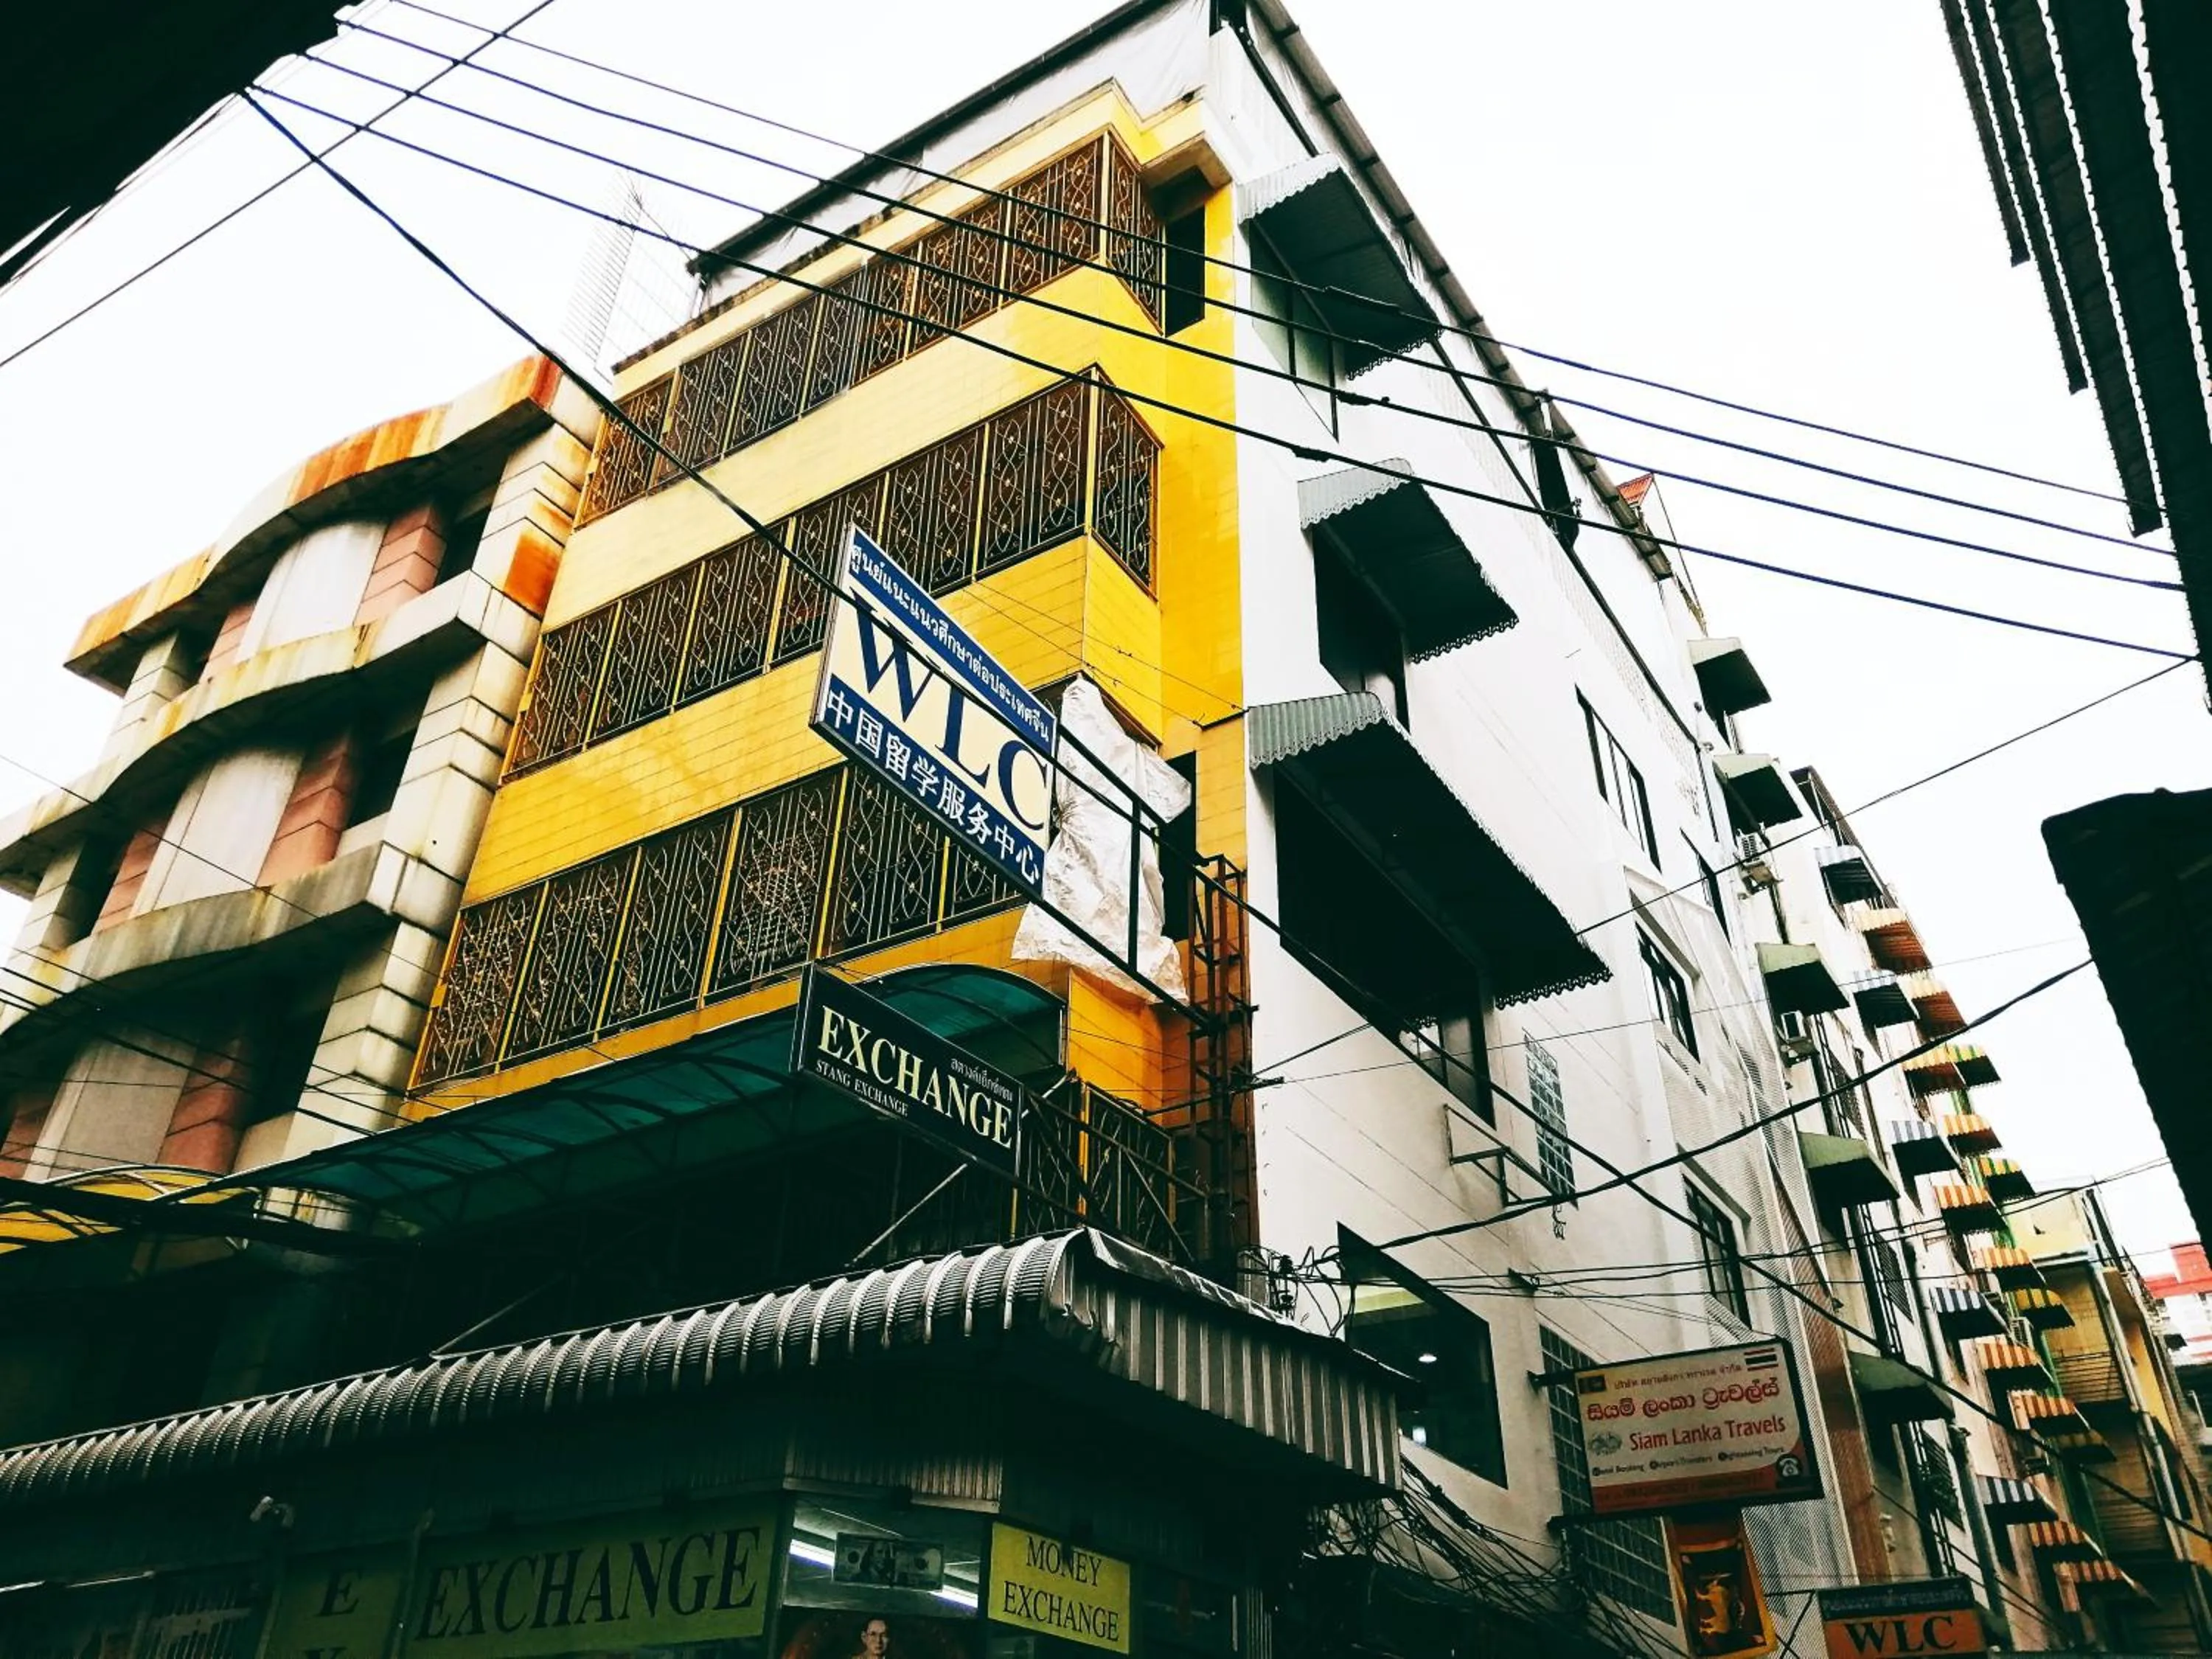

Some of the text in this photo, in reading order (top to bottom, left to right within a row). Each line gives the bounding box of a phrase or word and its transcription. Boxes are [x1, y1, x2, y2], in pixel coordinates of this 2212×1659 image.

[849, 586, 1048, 831] WLC
[827, 689, 1039, 885] 中国留学服务中心
[816, 1059, 908, 1116] STANG EXCHANGE
[817, 1005, 1012, 1149] EXCHANGE
[1630, 1415, 1786, 1451] Siam Lanka Travels
[414, 1527, 762, 1641] EXCHANGE
[1003, 1580, 1119, 1642] EXCHANGE
[1844, 1615, 1958, 1654] WLC
